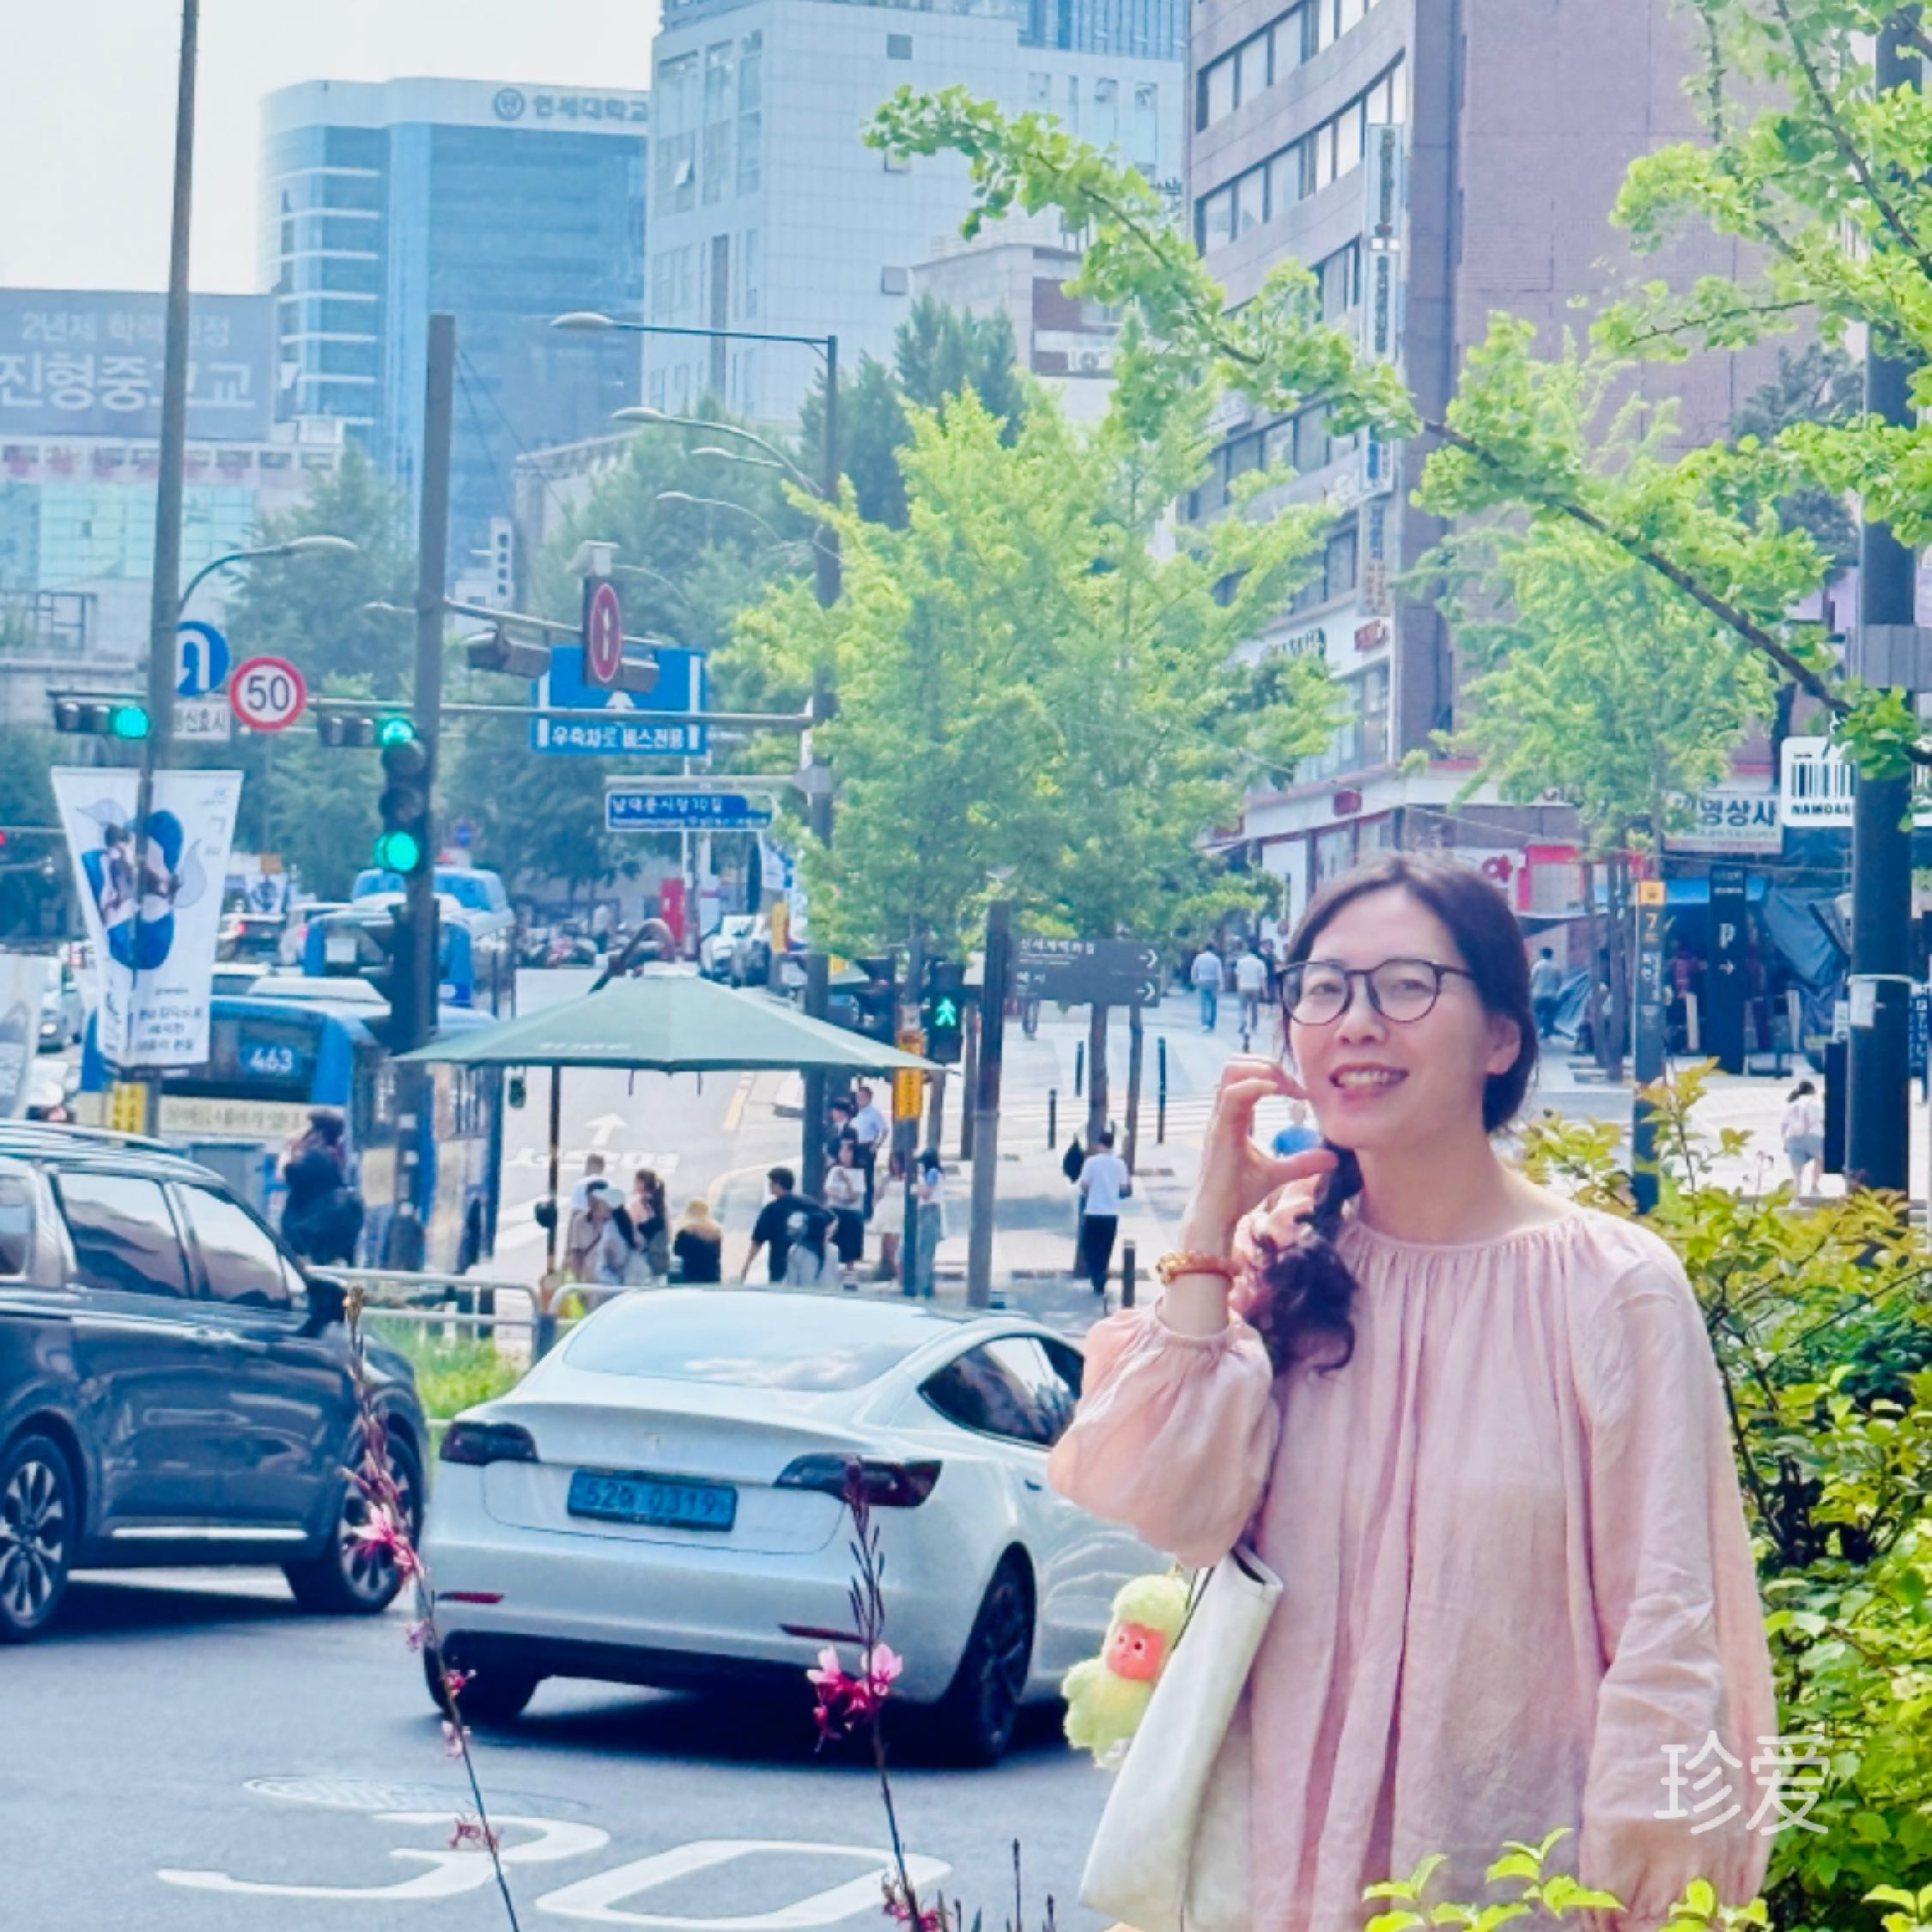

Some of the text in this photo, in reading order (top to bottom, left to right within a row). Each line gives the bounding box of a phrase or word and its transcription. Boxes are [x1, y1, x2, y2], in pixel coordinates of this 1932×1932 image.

[246, 675, 290, 711] 50
[1719, 922, 1736, 949] P
[250, 1047, 294, 1072] 463
